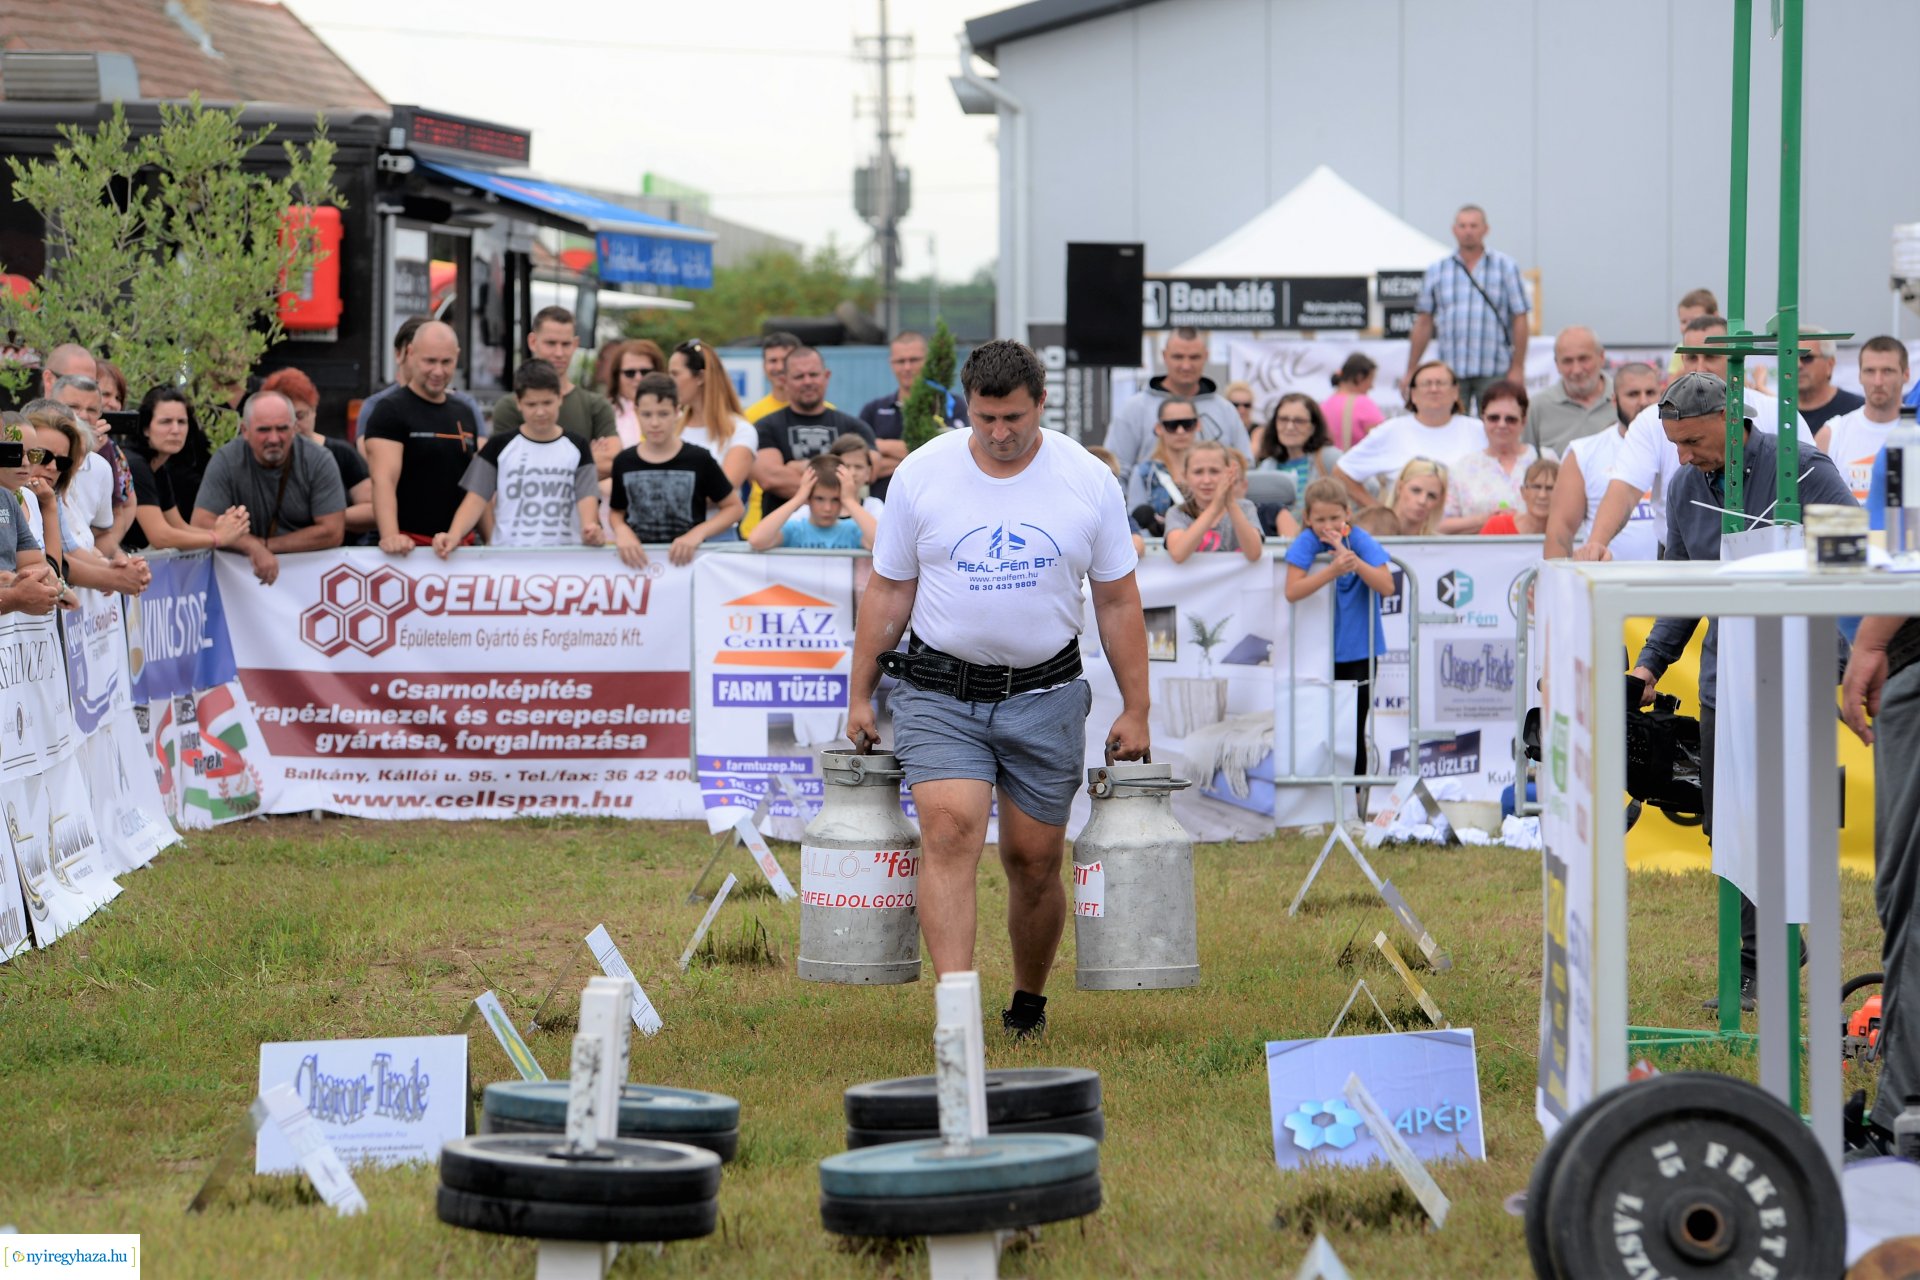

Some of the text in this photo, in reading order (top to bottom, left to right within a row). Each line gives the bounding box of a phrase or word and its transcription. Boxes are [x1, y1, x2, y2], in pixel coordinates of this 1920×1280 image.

[1169, 278, 1276, 311] Borháló
[506, 477, 574, 500] down
[515, 498, 572, 519] load
[969, 571, 1039, 583] www.realfem.hu
[1015, 580, 1037, 589] 9809
[413, 573, 651, 616] CELLSPAN
[144, 591, 214, 664] KINGSTOE
[760, 608, 836, 635] HÁZ
[399, 626, 644, 652] Épületelem Gyártó és Forgalmazó Kft.
[724, 635, 840, 649] Centrum
[387, 678, 593, 704] Csarnoképítés
[718, 680, 774, 702] FARM
[249, 702, 691, 729] rapézlemezek és cserepesleme
[315, 730, 648, 756] gyártása, forgalmazása
[284, 768, 371, 784] Balkány,
[378, 769, 438, 782] Kállói
[444, 771, 462, 782] u.
[468, 770, 498, 782] 95.
[604, 769, 628, 782] 36
[633, 769, 658, 782] 42
[726, 759, 806, 773] farmtuzep.hu
[332, 789, 634, 812] www.cellspan.hu
[294, 1052, 431, 1126] Charon-Trade
[1369, 1096, 1473, 1136] APÉP
[1651, 1140, 1687, 1178] 15
[1704, 1140, 1788, 1280] FEKETE
